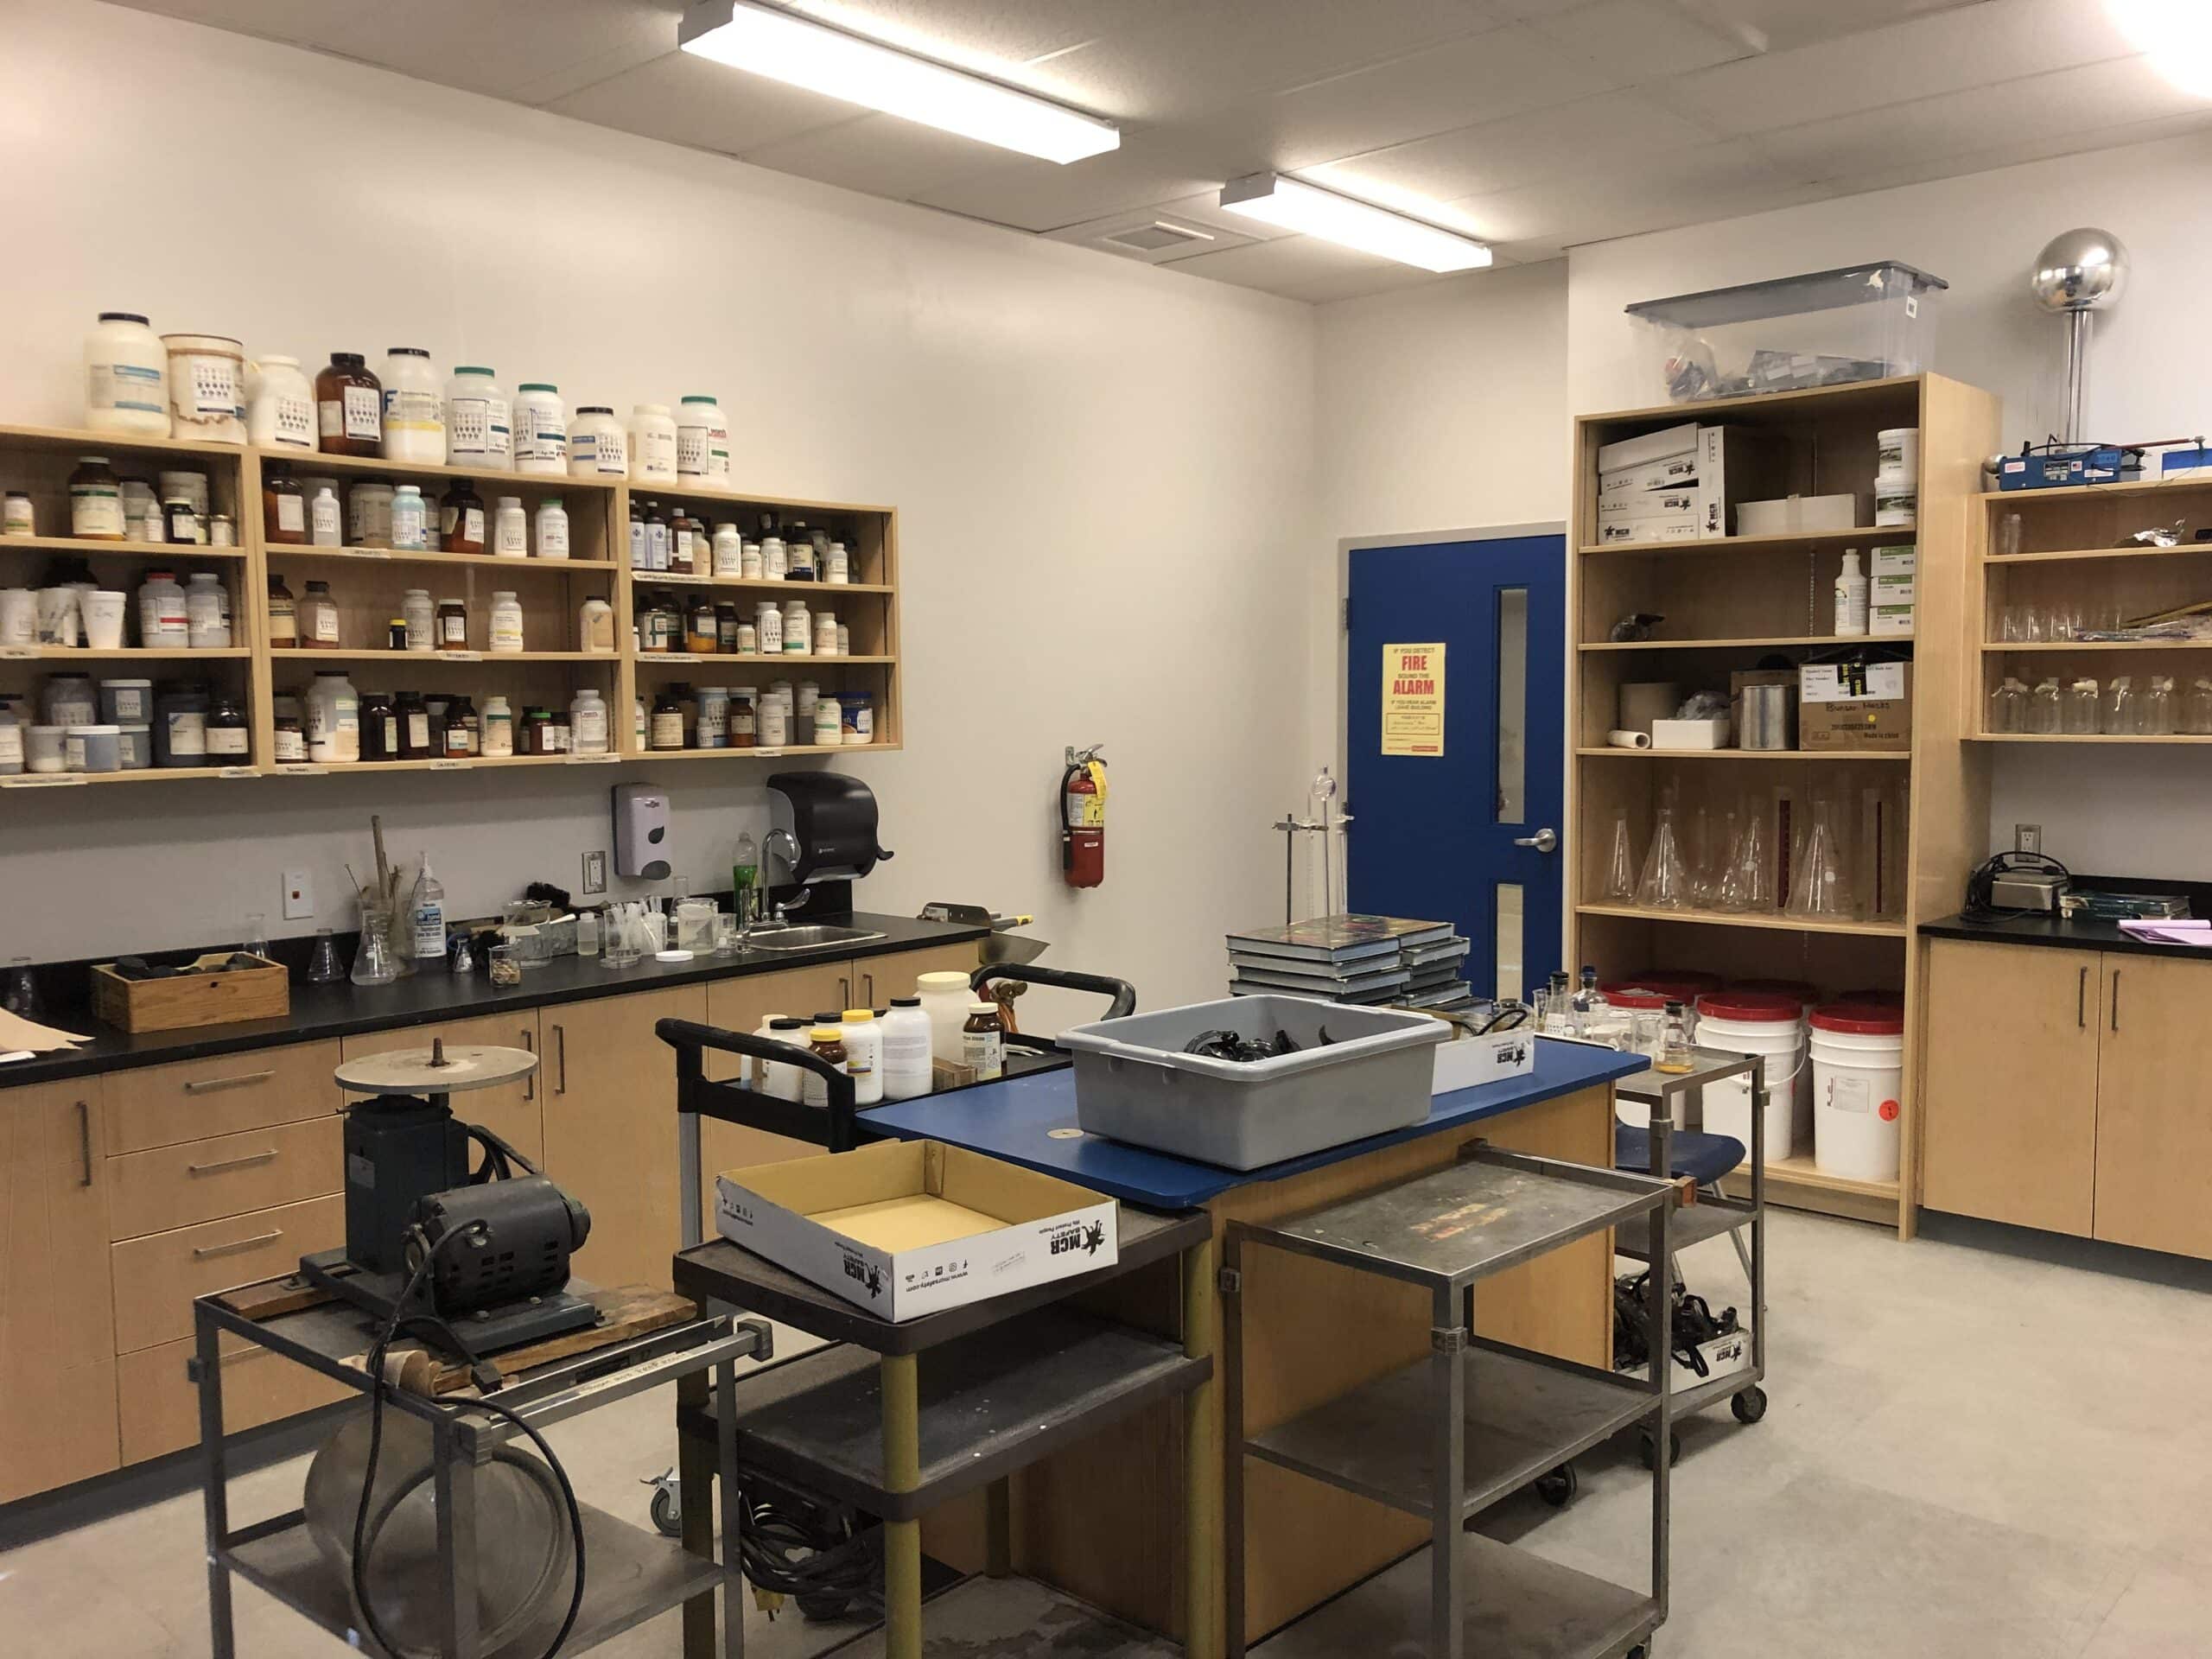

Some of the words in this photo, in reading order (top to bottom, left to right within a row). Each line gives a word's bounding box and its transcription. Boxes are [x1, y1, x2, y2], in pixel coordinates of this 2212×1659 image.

[1402, 656, 1427, 671] FIRE
[1393, 680, 1434, 695] ALARM
[1497, 1051, 1513, 1064] MCR
[1051, 1226, 1080, 1239] SAFETY
[1050, 1234, 1081, 1255] MCR
[842, 1259, 865, 1283] MCR
[906, 1271, 969, 1293] www.mcrsafety.com
[1716, 1350, 1731, 1362] MCR
